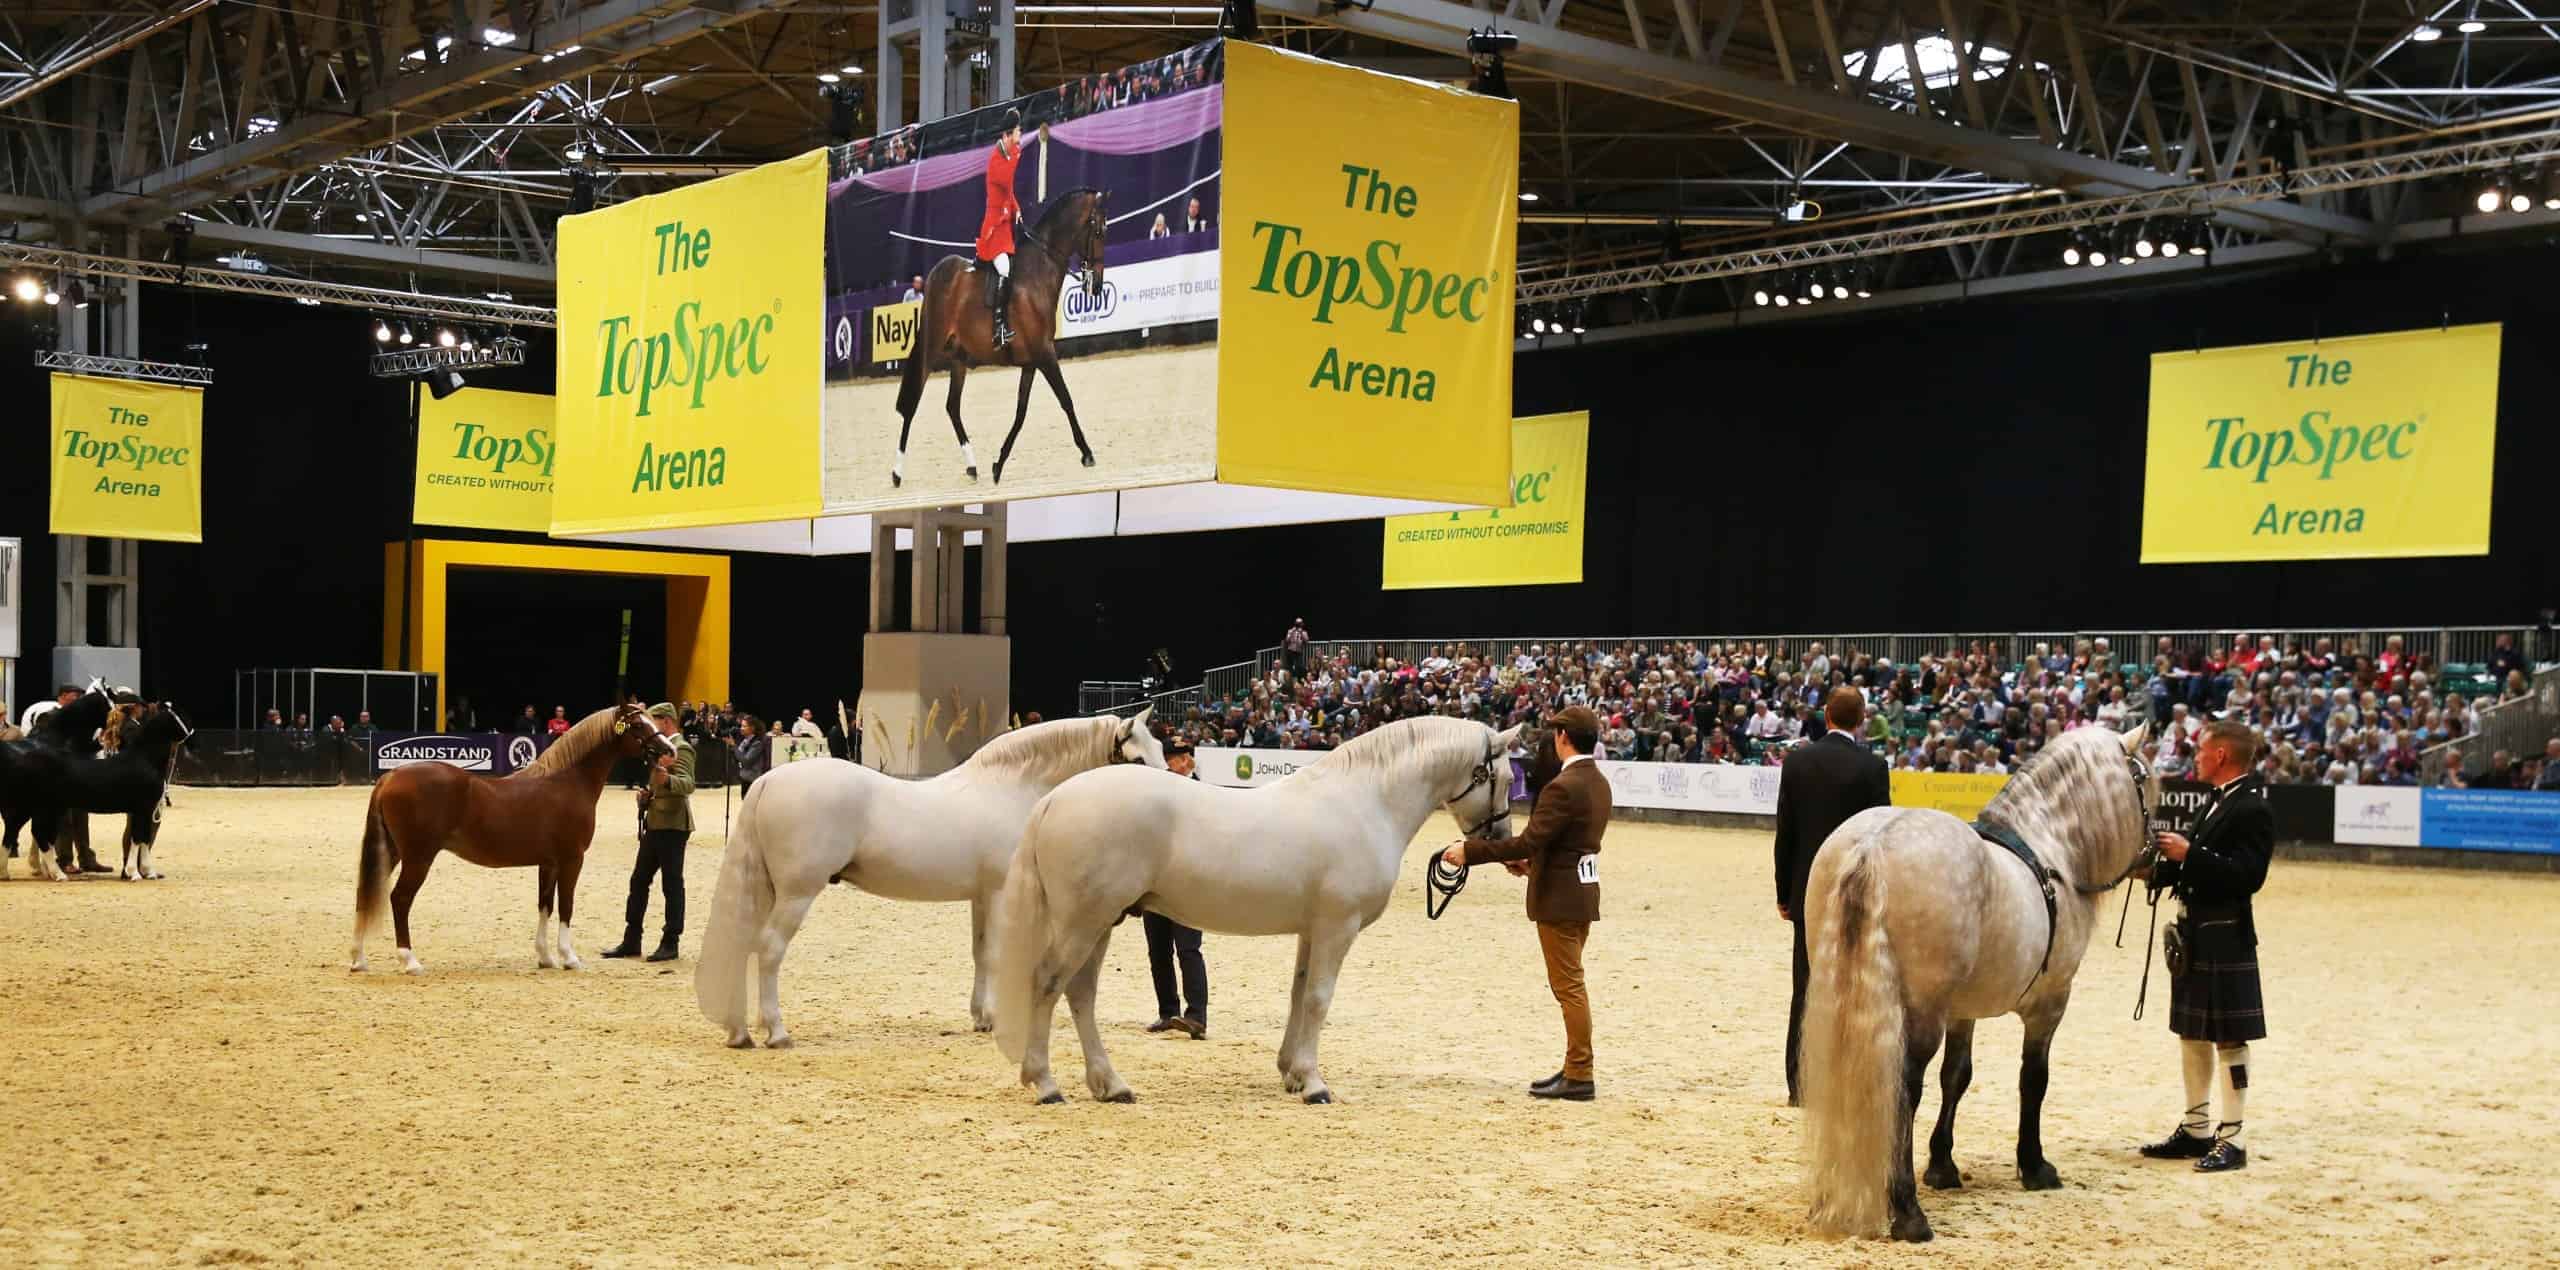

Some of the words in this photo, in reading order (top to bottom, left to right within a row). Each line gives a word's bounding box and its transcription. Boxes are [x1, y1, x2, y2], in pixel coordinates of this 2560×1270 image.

[1341, 164, 1418, 218] The
[654, 220, 712, 276] The
[1138, 284, 1177, 301] PREPARE
[1178, 281, 1193, 295] TO
[1251, 220, 1489, 334] TopSpec
[596, 300, 774, 418] TopSpec
[1310, 347, 1437, 402] Arena
[2285, 353, 2354, 388] The
[108, 406, 149, 427] The
[64, 429, 190, 472] TopSpec
[2202, 410, 2418, 484] TopSpec
[426, 473, 486, 488] CREATED
[489, 479, 546, 493] WITHOUT
[631, 442, 727, 494] Arena
[94, 475, 161, 498] Arena
[1398, 528, 1445, 543] CREATED
[1446, 525, 1494, 541] WITHOUT
[1495, 521, 1569, 538] COMPROMISE
[2252, 503, 2366, 536] Arena
[378, 746, 492, 760] GRANDSTAND
[1255, 762, 1283, 776] JOHN
